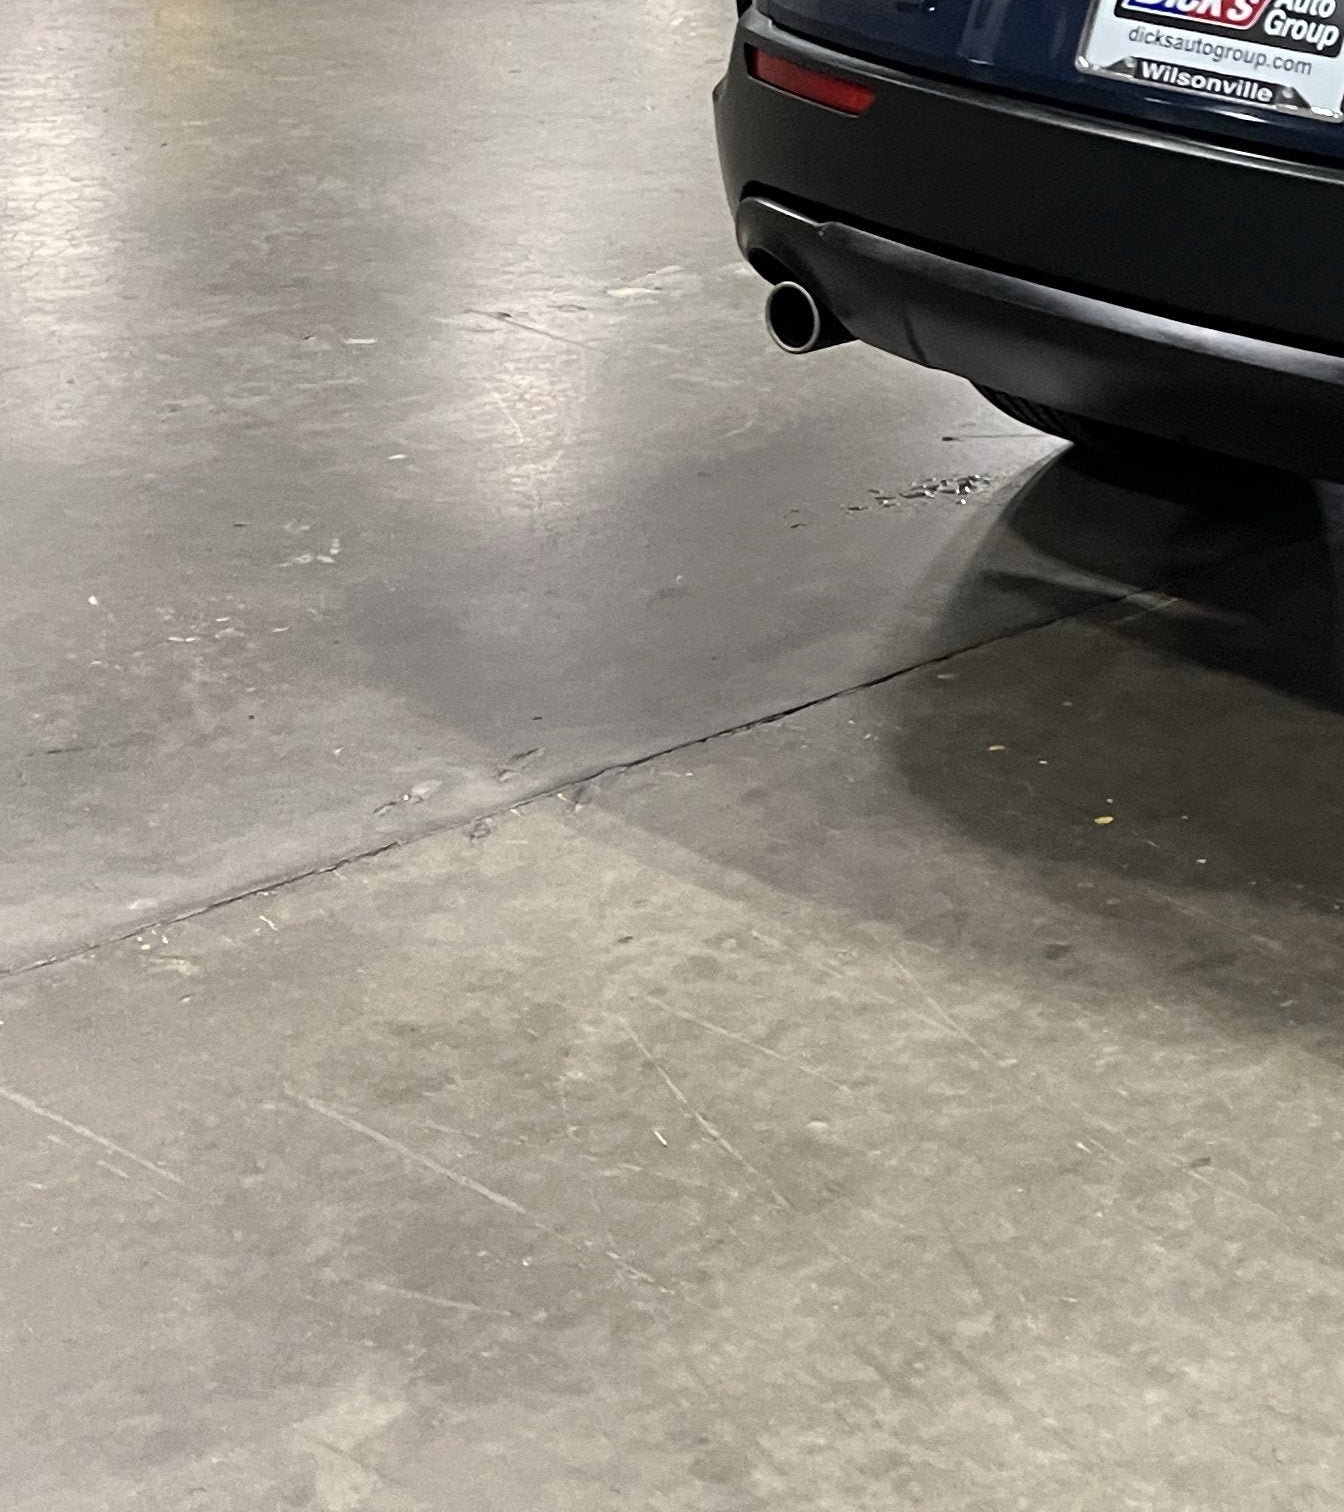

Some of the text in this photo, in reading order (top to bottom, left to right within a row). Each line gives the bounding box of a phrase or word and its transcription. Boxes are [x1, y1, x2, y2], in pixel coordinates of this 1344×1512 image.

[1128, 25, 1313, 76] dicksautogroup.com
[1263, 9, 1340, 50] Group
[1142, 61, 1274, 103] Wilsonville
